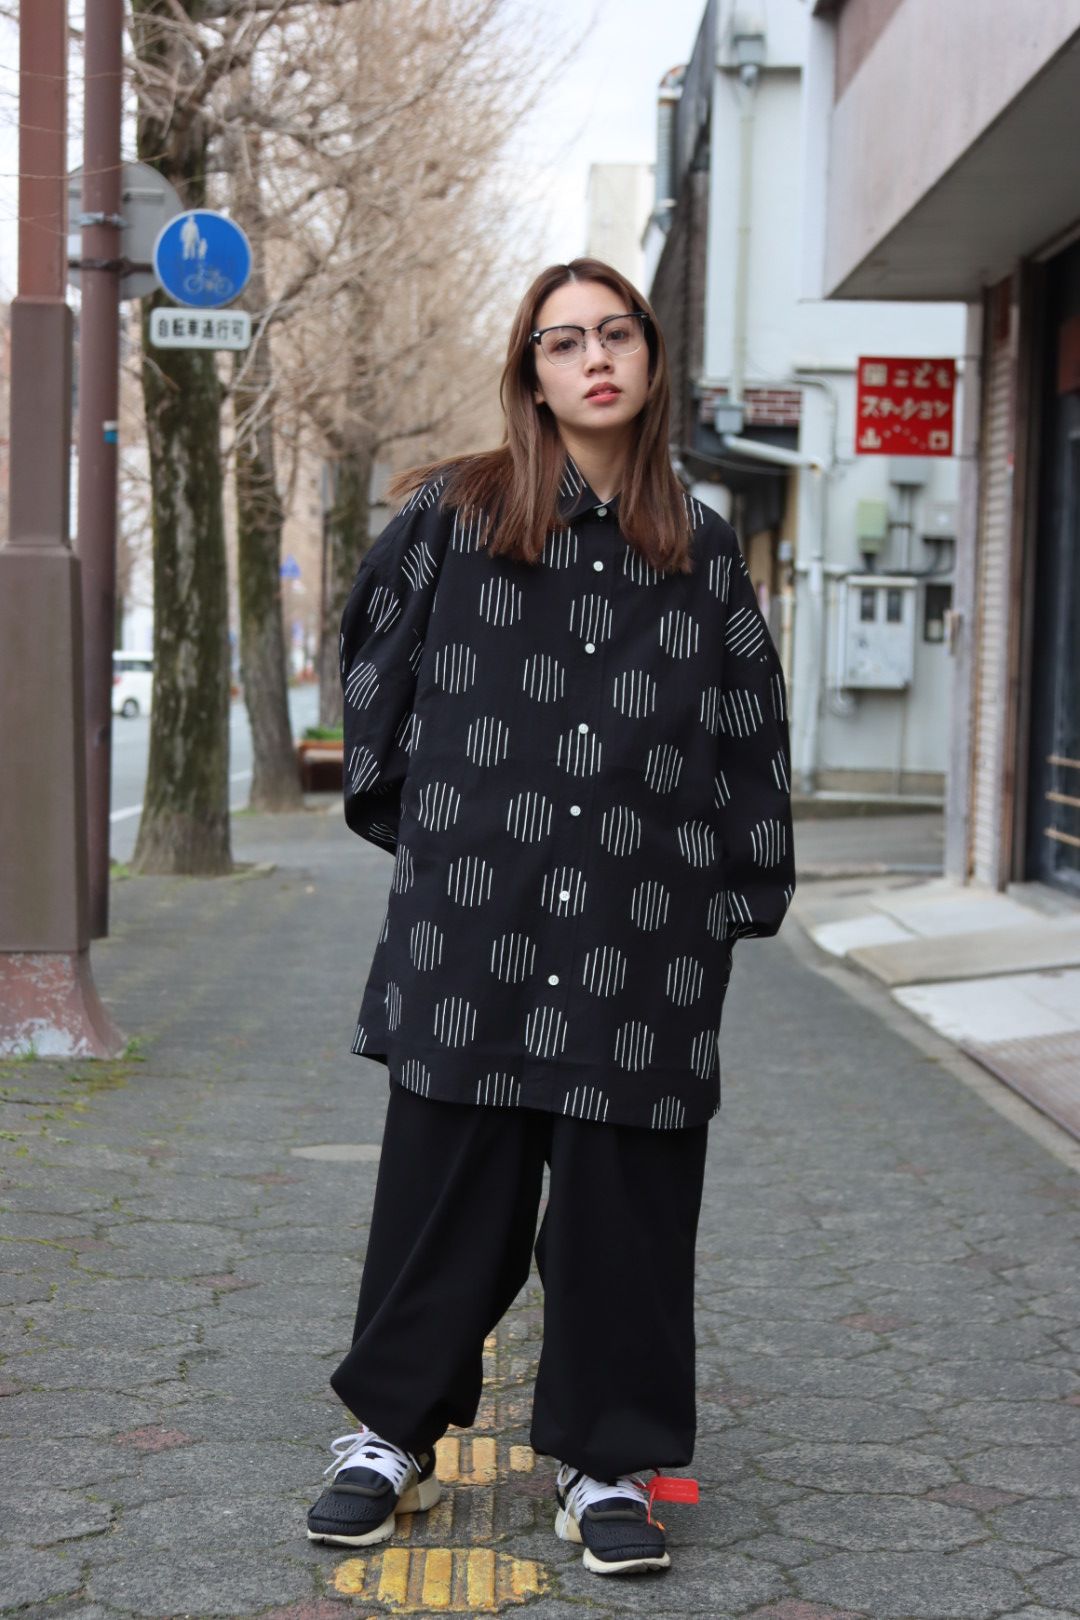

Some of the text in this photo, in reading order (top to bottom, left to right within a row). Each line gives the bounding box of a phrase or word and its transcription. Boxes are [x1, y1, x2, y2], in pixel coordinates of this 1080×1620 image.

[158, 318, 244, 341] 自転車通行可
[862, 396, 950, 420] ステーション
